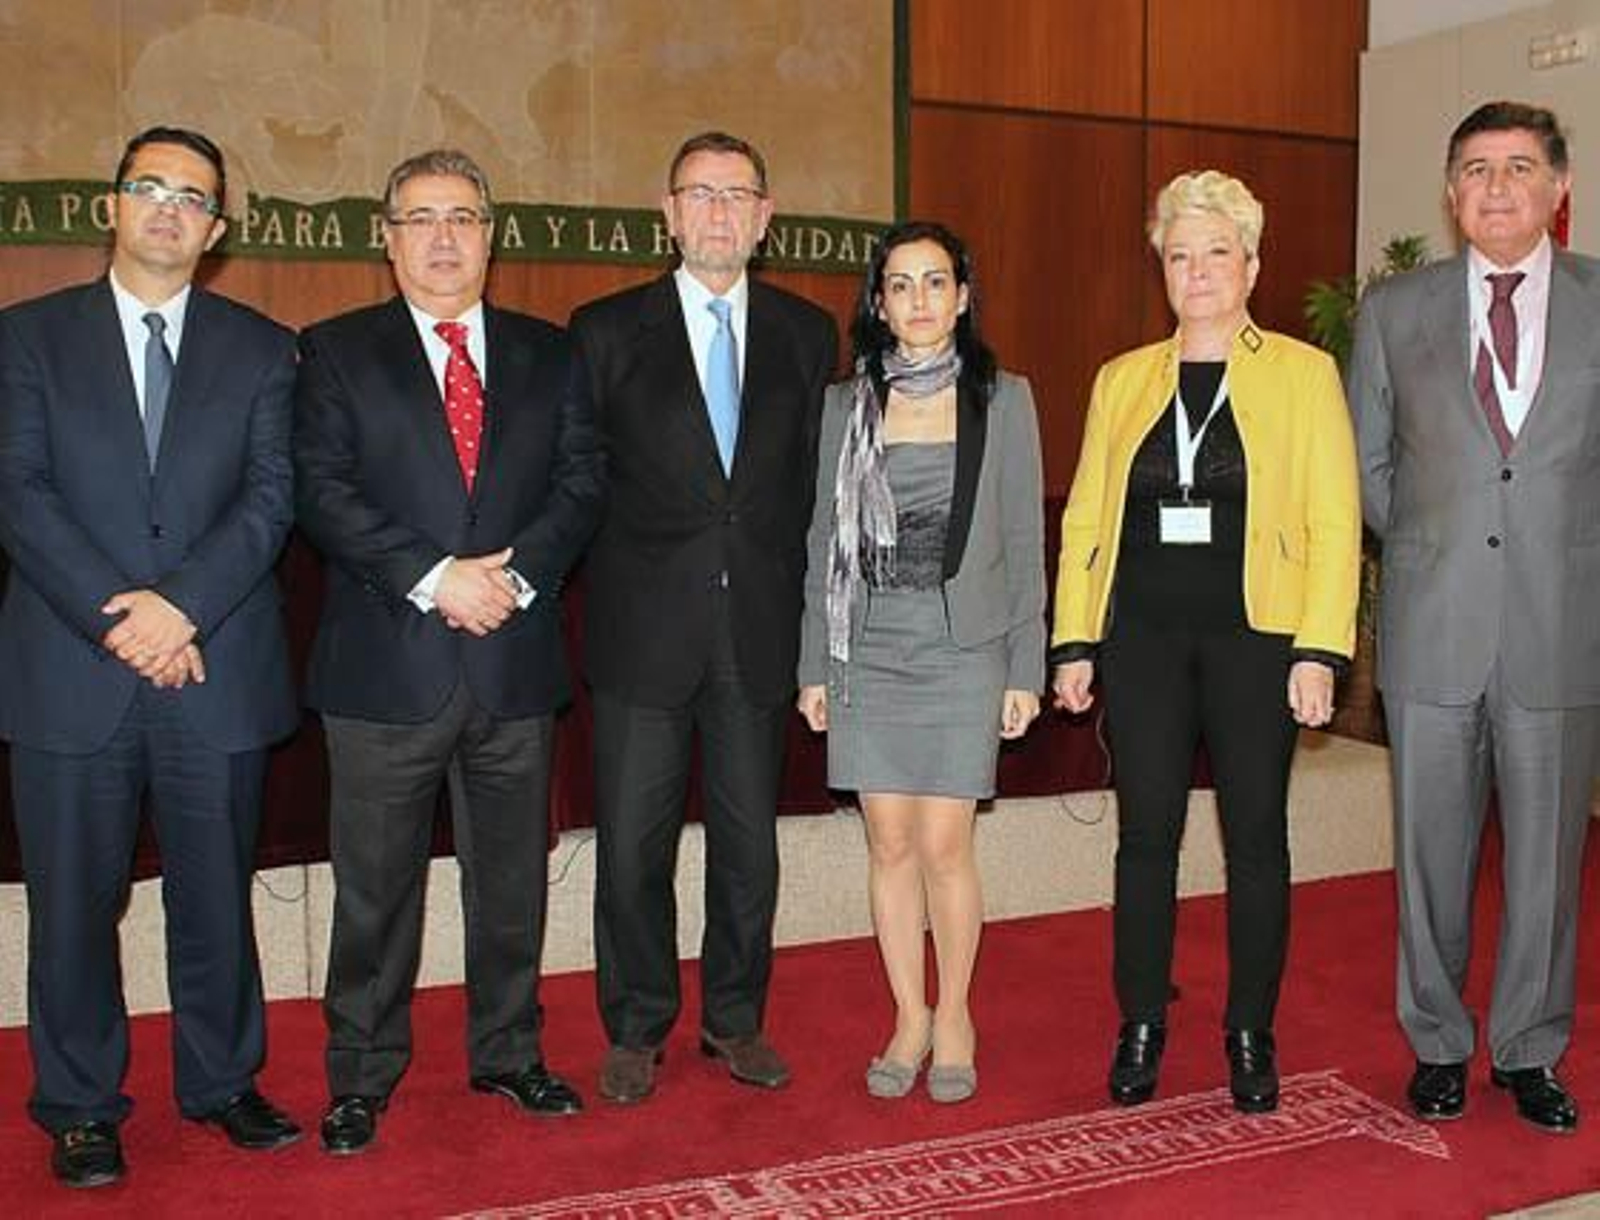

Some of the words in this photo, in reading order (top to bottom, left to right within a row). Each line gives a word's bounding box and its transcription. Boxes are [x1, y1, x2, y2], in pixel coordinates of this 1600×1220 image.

[60, 193, 108, 231] PO
[241, 209, 343, 247] PARA
[547, 216, 566, 248] Y
[588, 219, 629, 251] LA
